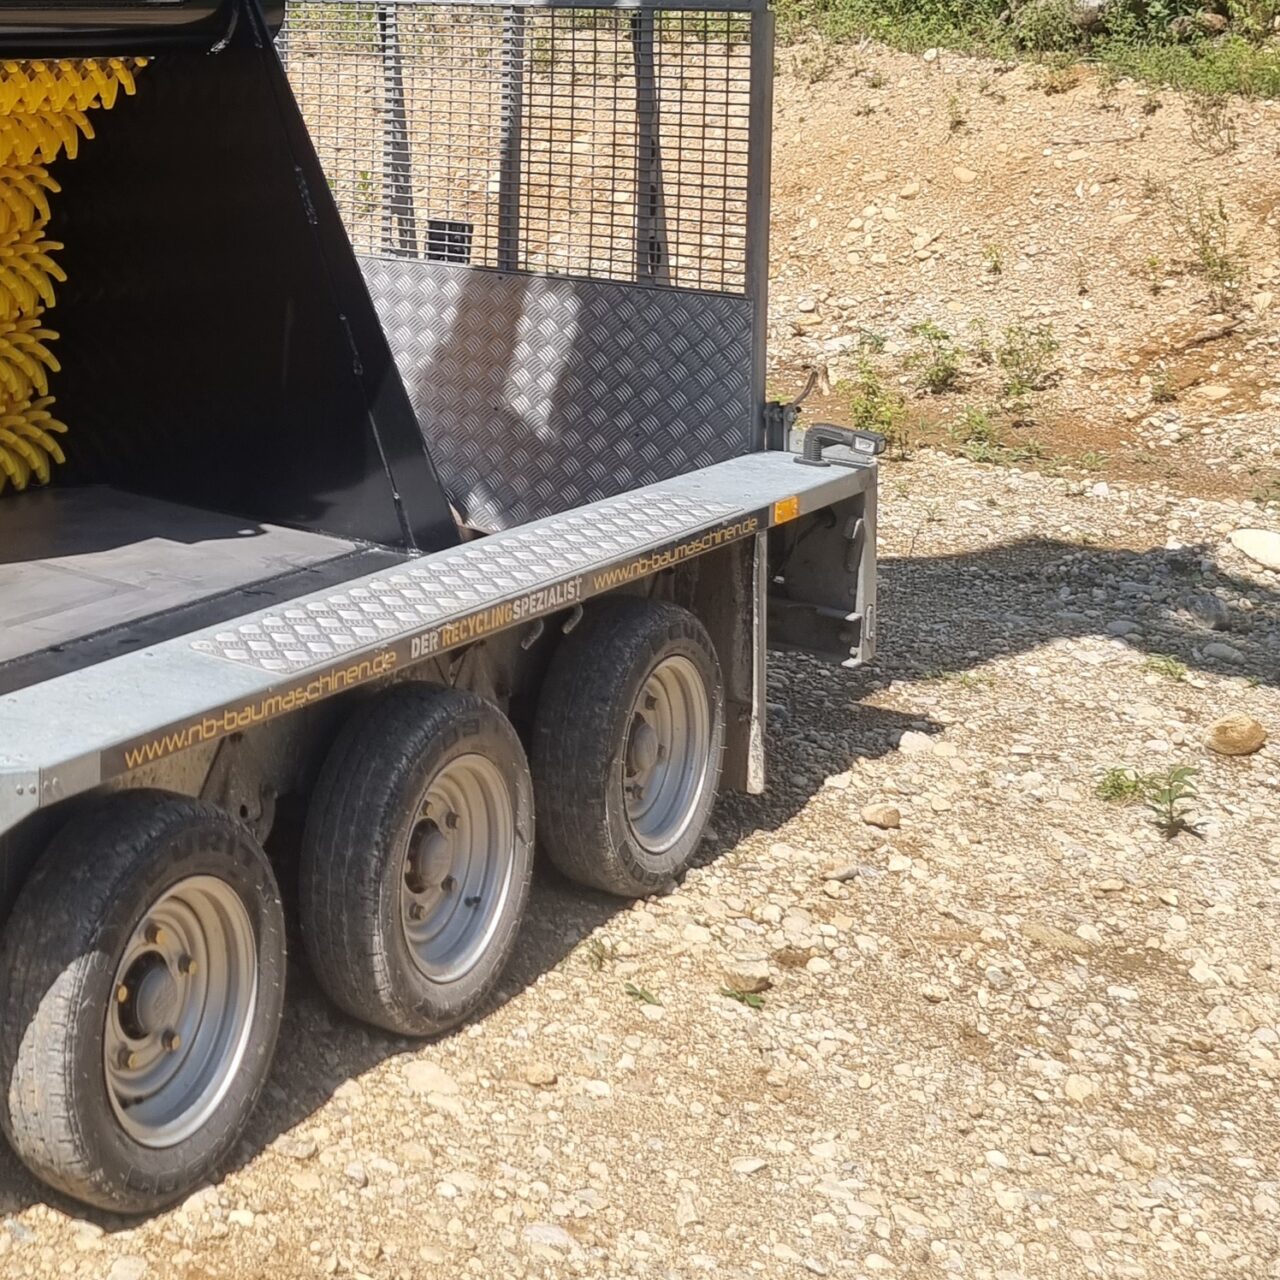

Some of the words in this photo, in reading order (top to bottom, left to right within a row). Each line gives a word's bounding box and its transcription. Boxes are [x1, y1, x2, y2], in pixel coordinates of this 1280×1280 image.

[593, 517, 758, 590] www.nb-baumaschinen.de
[410, 630, 439, 659] DER
[124, 651, 397, 769] www.nb-baumaschinen.de
